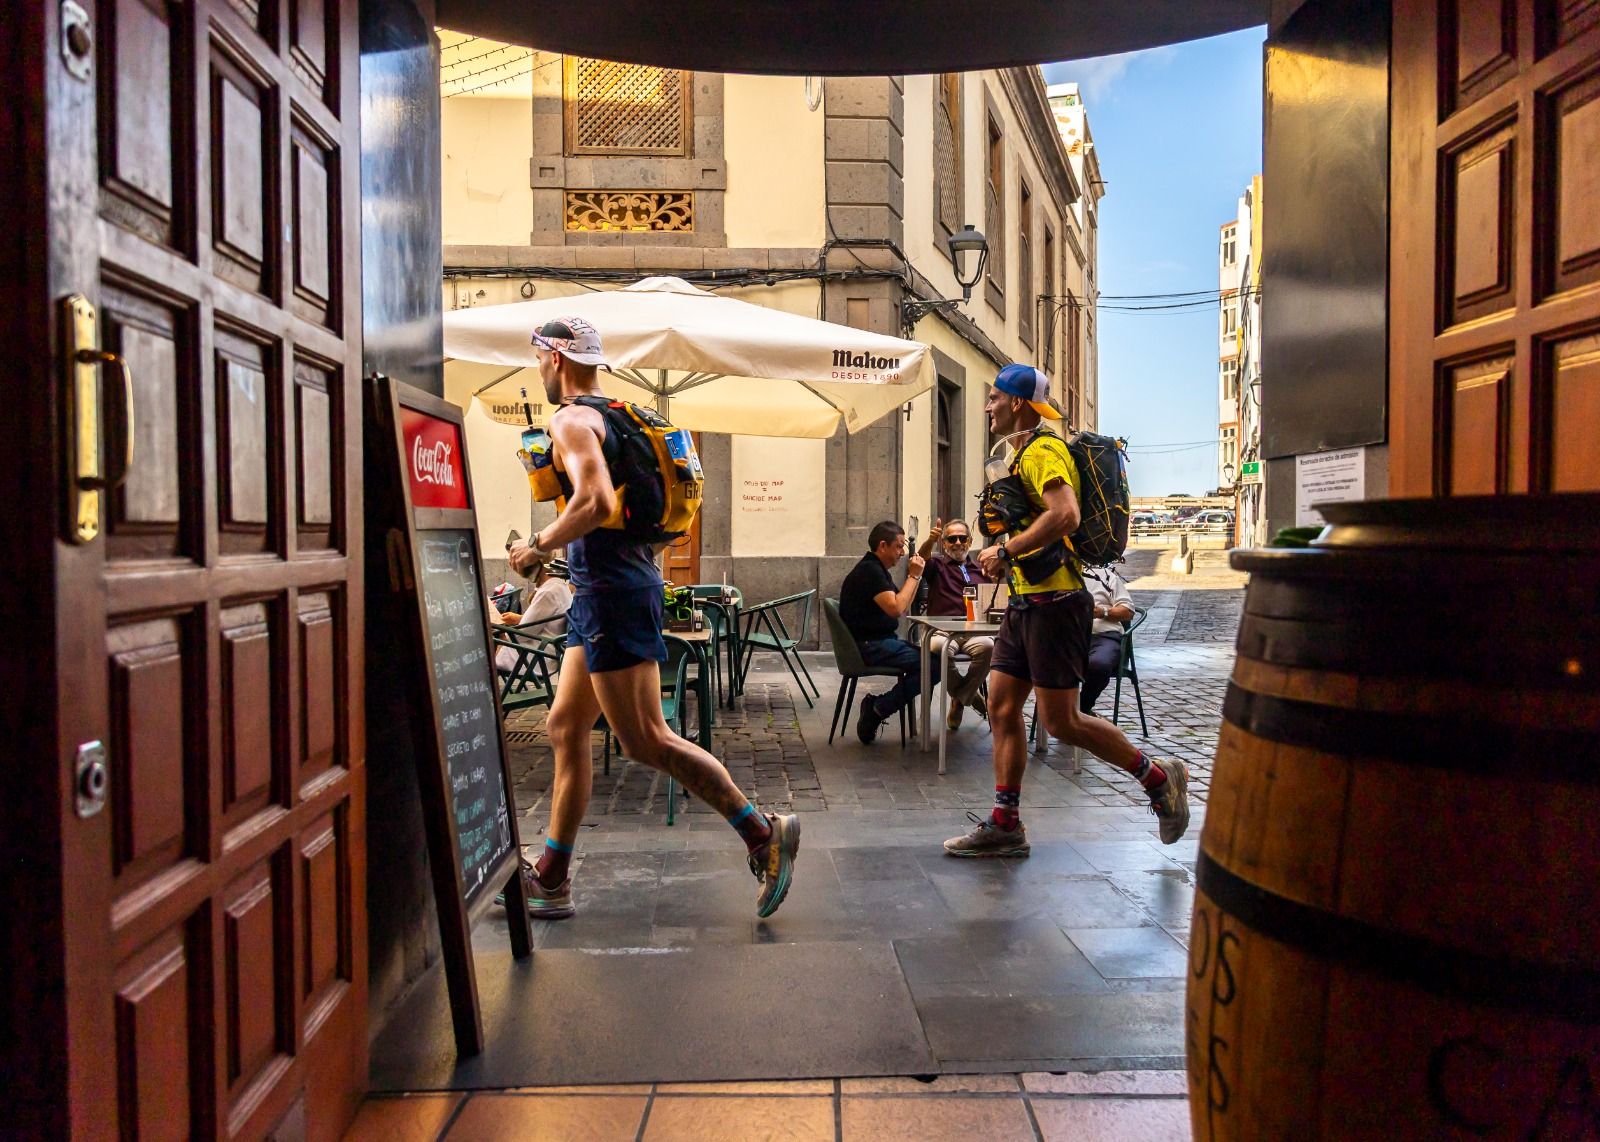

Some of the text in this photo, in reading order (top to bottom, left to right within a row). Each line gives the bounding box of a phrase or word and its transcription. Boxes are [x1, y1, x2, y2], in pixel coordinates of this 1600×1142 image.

[832, 349, 900, 370] Mahou
[831, 371, 899, 381] DESDE 1890
[447, 741, 470, 757] SECRETO
